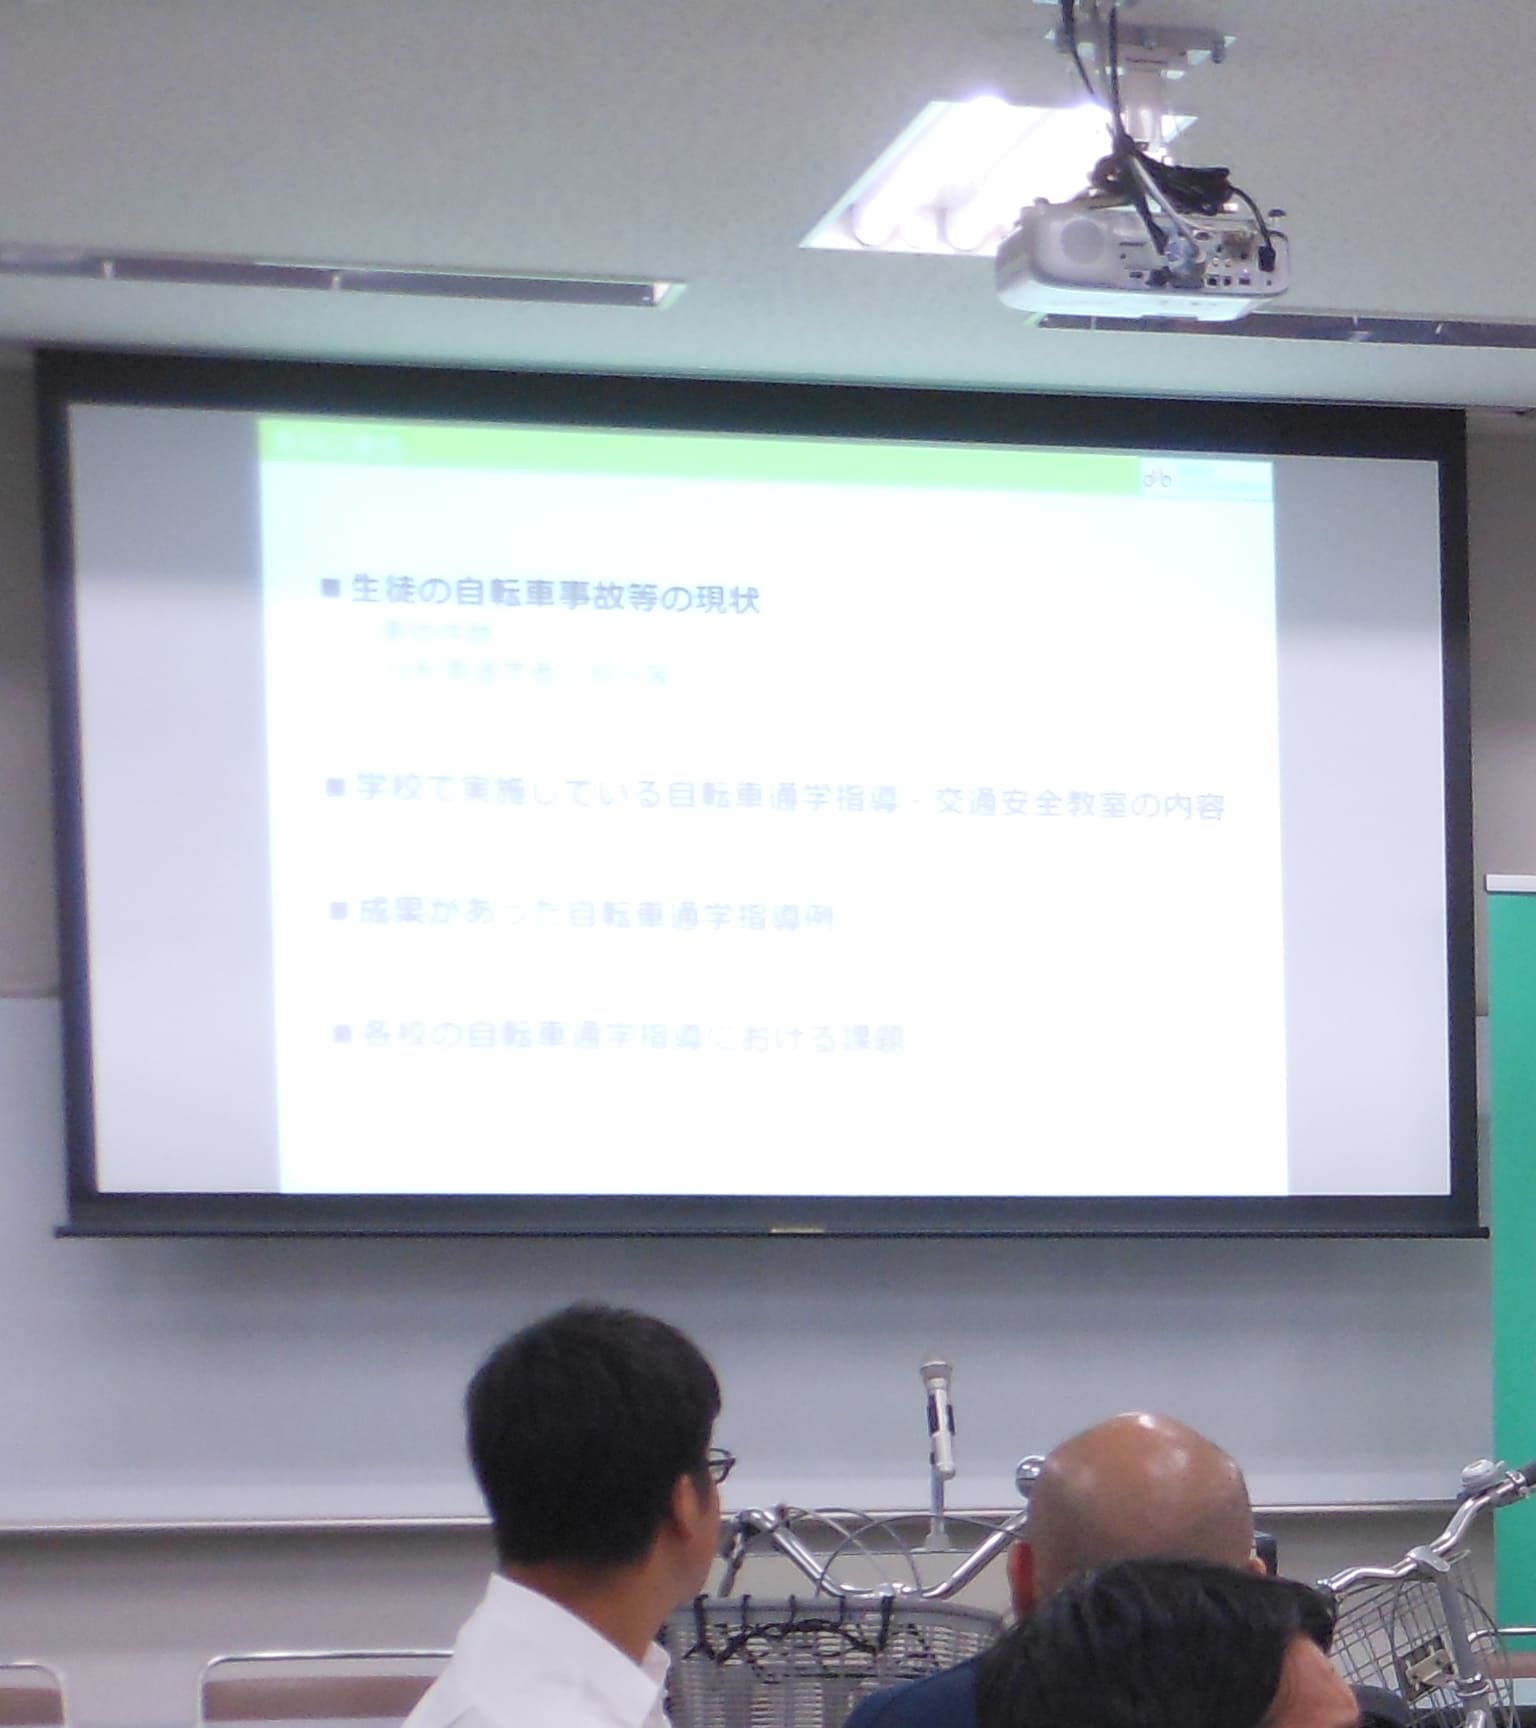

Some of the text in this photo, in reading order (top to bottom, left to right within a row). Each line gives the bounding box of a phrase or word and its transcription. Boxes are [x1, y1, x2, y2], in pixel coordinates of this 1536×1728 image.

[351, 573, 761, 614] 生徒の自転車事故等の現状
